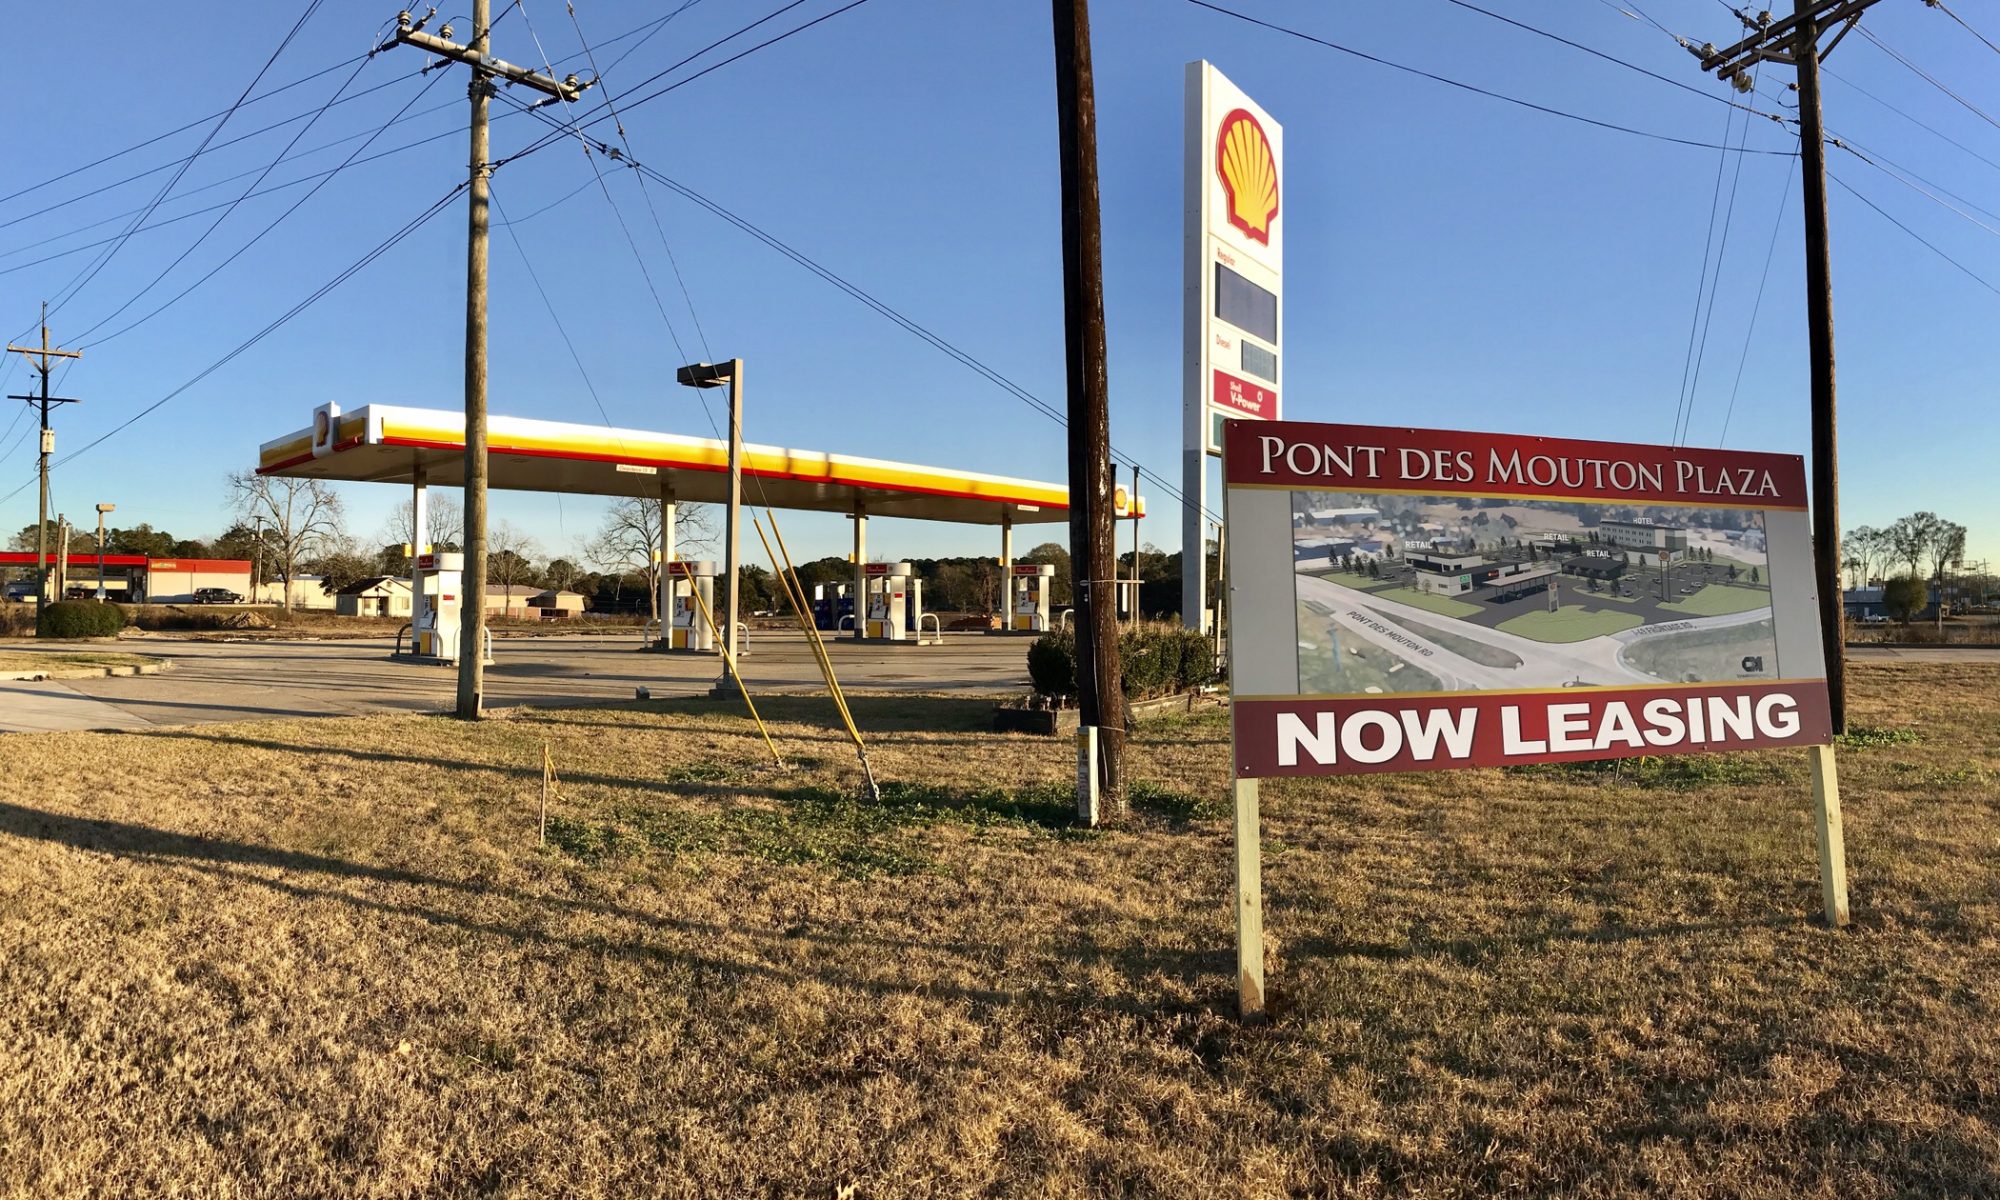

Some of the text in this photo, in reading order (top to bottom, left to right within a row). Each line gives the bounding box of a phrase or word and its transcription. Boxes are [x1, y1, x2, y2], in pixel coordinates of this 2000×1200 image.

[1230, 391, 1261, 412] V-Power
[1258, 435, 1781, 497] PONT DES MOUTON PLAZA
[1633, 517, 1654, 525] HOTEL
[1544, 533, 1569, 541] RETAIL
[1405, 541, 1432, 549] RETAIL
[1586, 550, 1610, 558] RETAIL
[1346, 610, 1434, 657] PONT DES MOUTON RD
[1276, 692, 1801, 767] NOW LEASING
